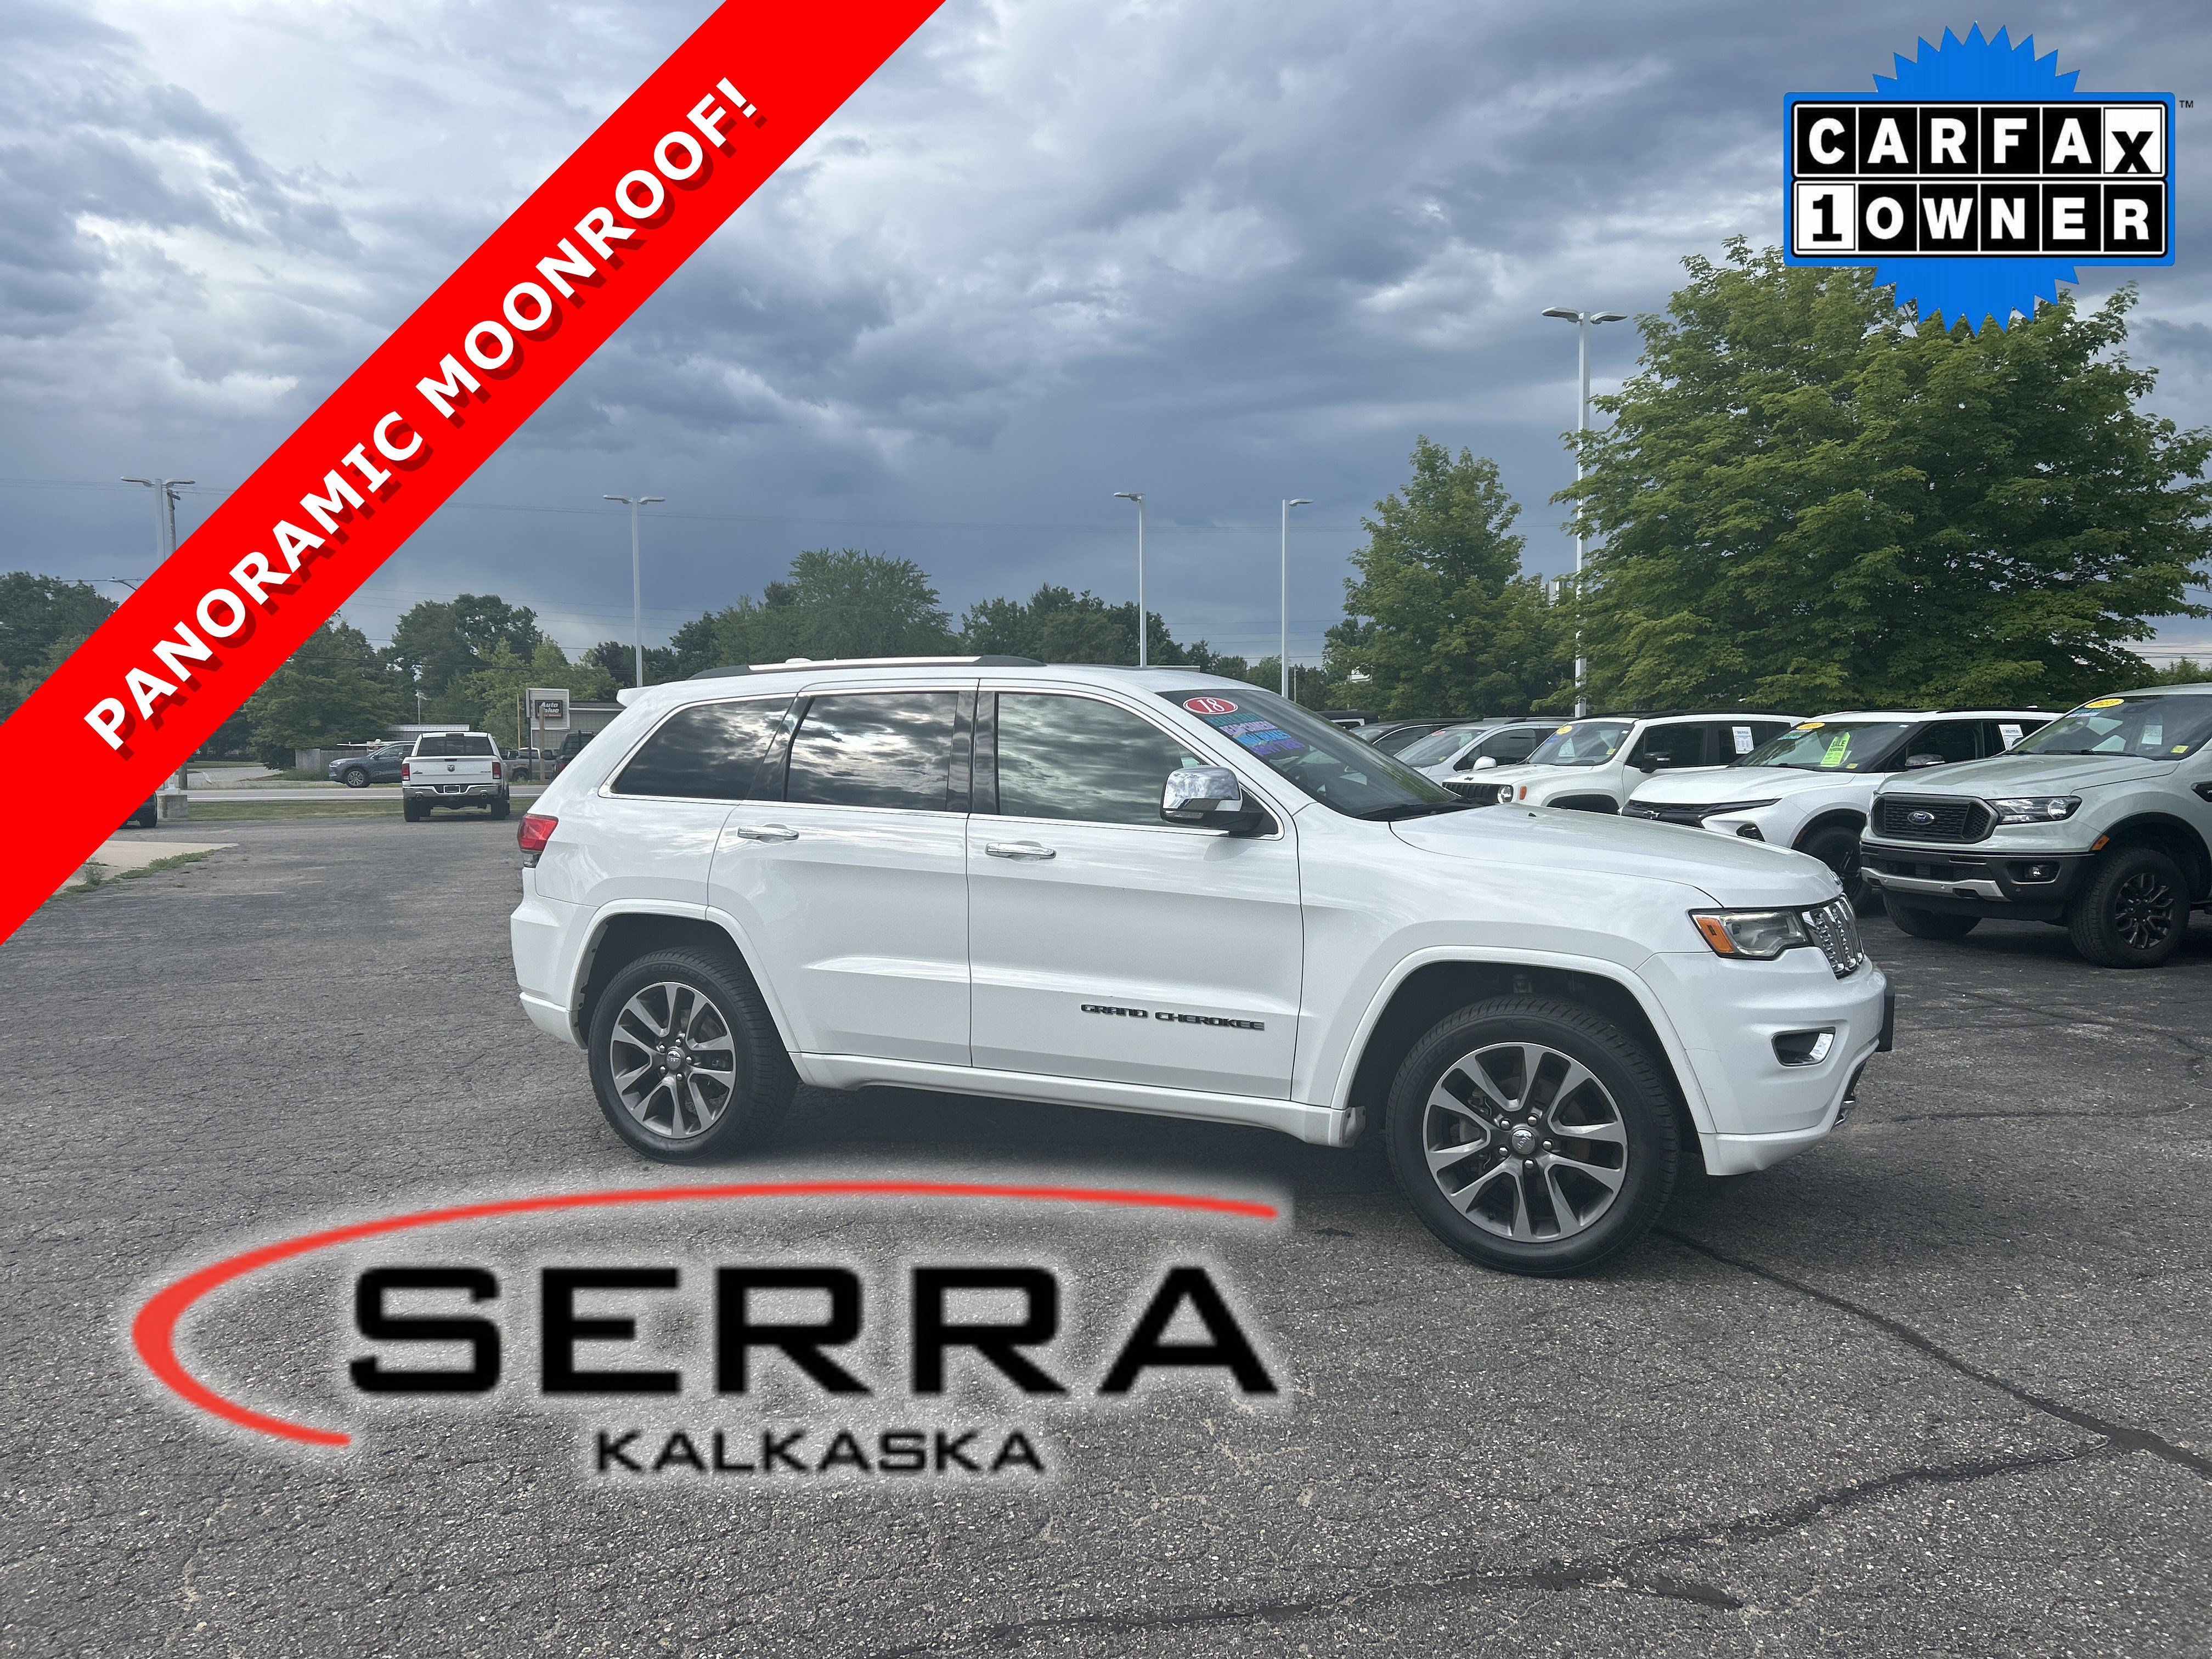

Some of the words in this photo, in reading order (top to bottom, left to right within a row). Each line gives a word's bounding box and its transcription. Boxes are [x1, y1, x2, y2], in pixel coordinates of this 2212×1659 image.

[1197, 698, 1224, 713] 18
[1831, 740, 1847, 748] SALE
[651, 964, 707, 984] COOPER
[1081, 1003, 1148, 1018] GRAND
[1155, 1012, 1265, 1031] CHEROKEE
